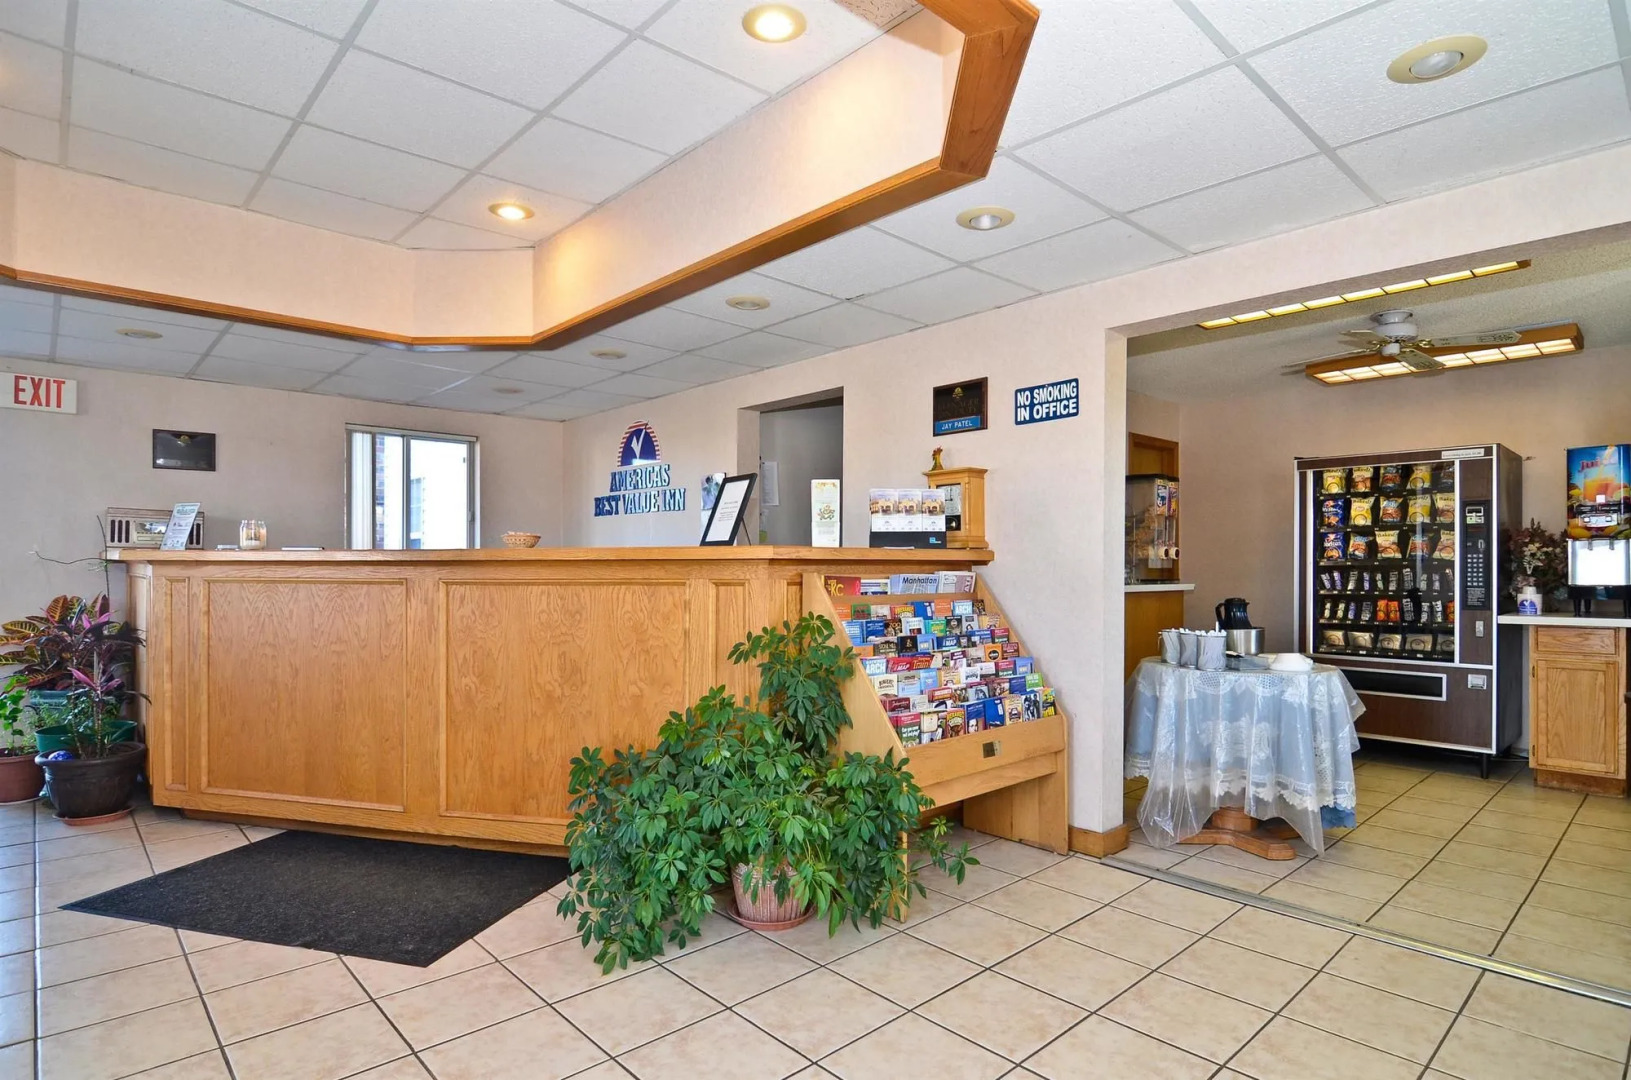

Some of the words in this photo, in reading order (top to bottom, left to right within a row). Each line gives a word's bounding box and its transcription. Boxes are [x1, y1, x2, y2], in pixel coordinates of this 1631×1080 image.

[13, 374, 66, 409] EXIT
[1017, 391, 1031, 407] NO
[1033, 381, 1077, 404] SMOKING
[1017, 406, 1030, 422] IN
[1033, 398, 1077, 419] OFFICE
[941, 420, 953, 430] JAY
[954, 418, 972, 428] PATEL
[609, 463, 671, 493] AMERICAS
[594, 494, 621, 517] BEST
[622, 489, 660, 515] VALUE
[661, 487, 686, 512] INN
[902, 576, 937, 585] Manhattan
[955, 605, 971, 614] ARCH
[866, 663, 885, 674] ARCH
